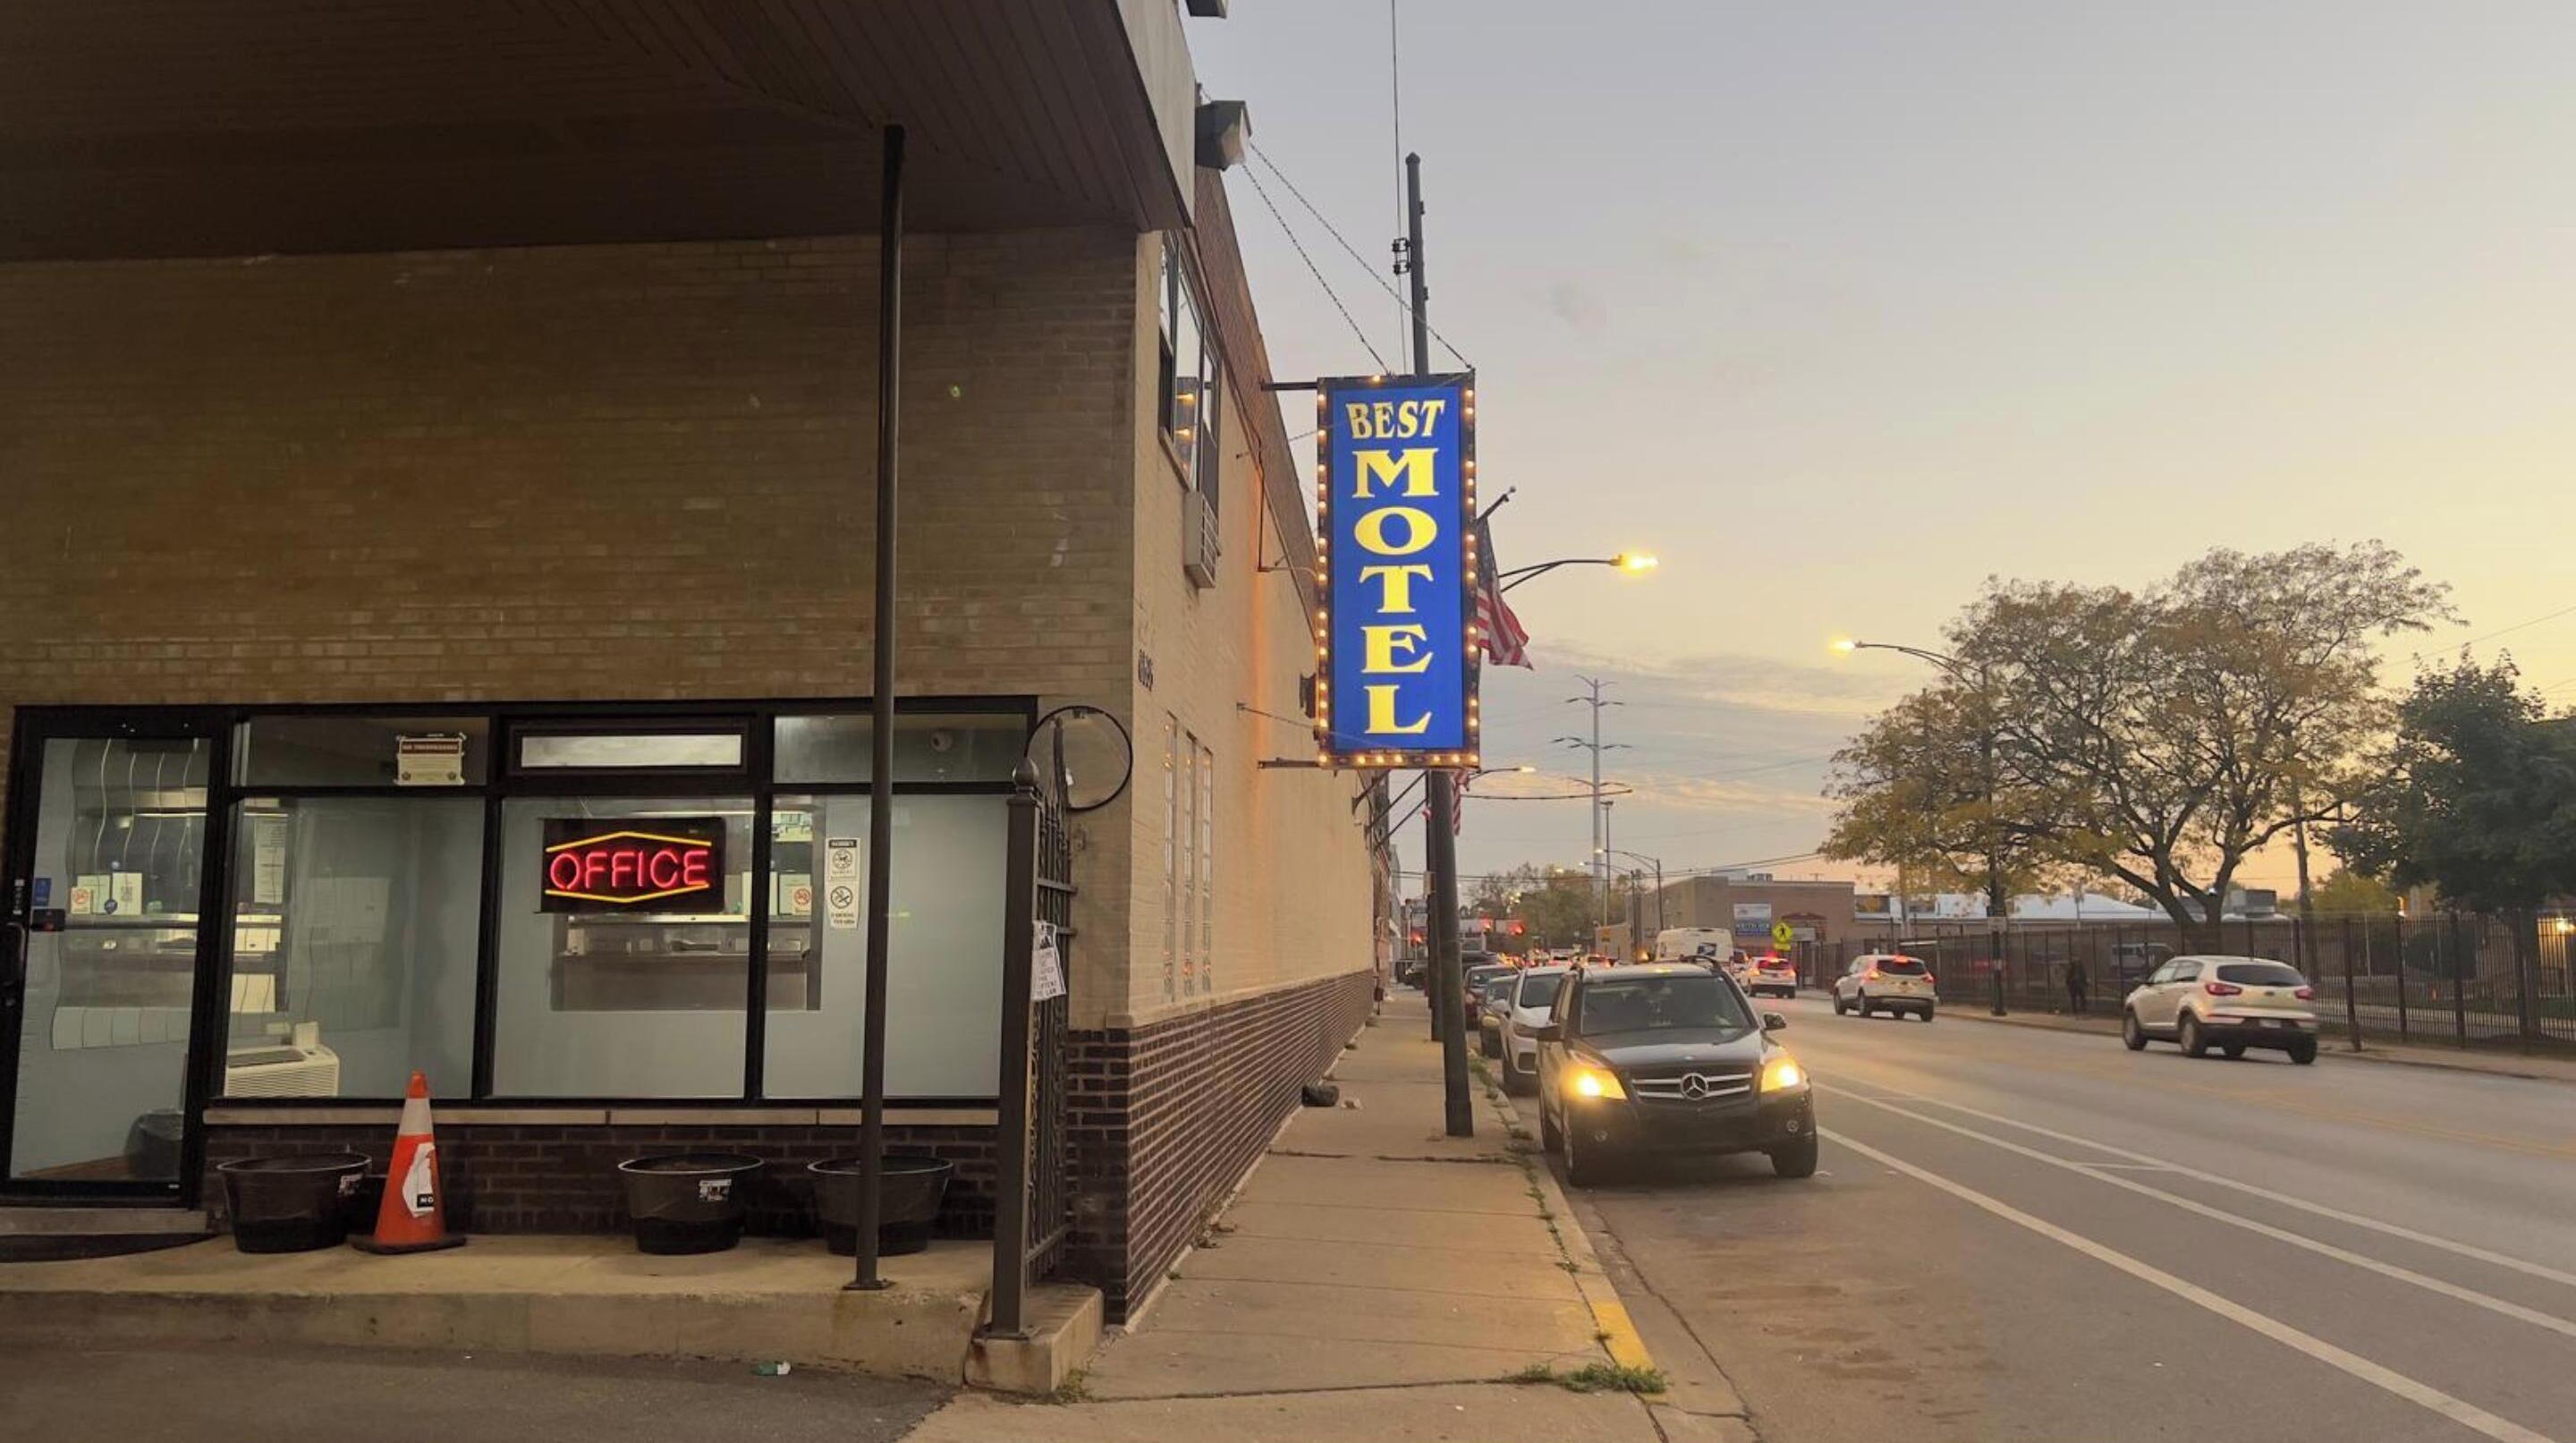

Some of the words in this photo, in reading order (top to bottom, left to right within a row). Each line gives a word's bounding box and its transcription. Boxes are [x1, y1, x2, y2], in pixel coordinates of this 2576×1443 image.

[1346, 399, 1445, 439] BEST
[1352, 447, 1440, 734] MOTEL
[549, 849, 709, 890] OFFICE
